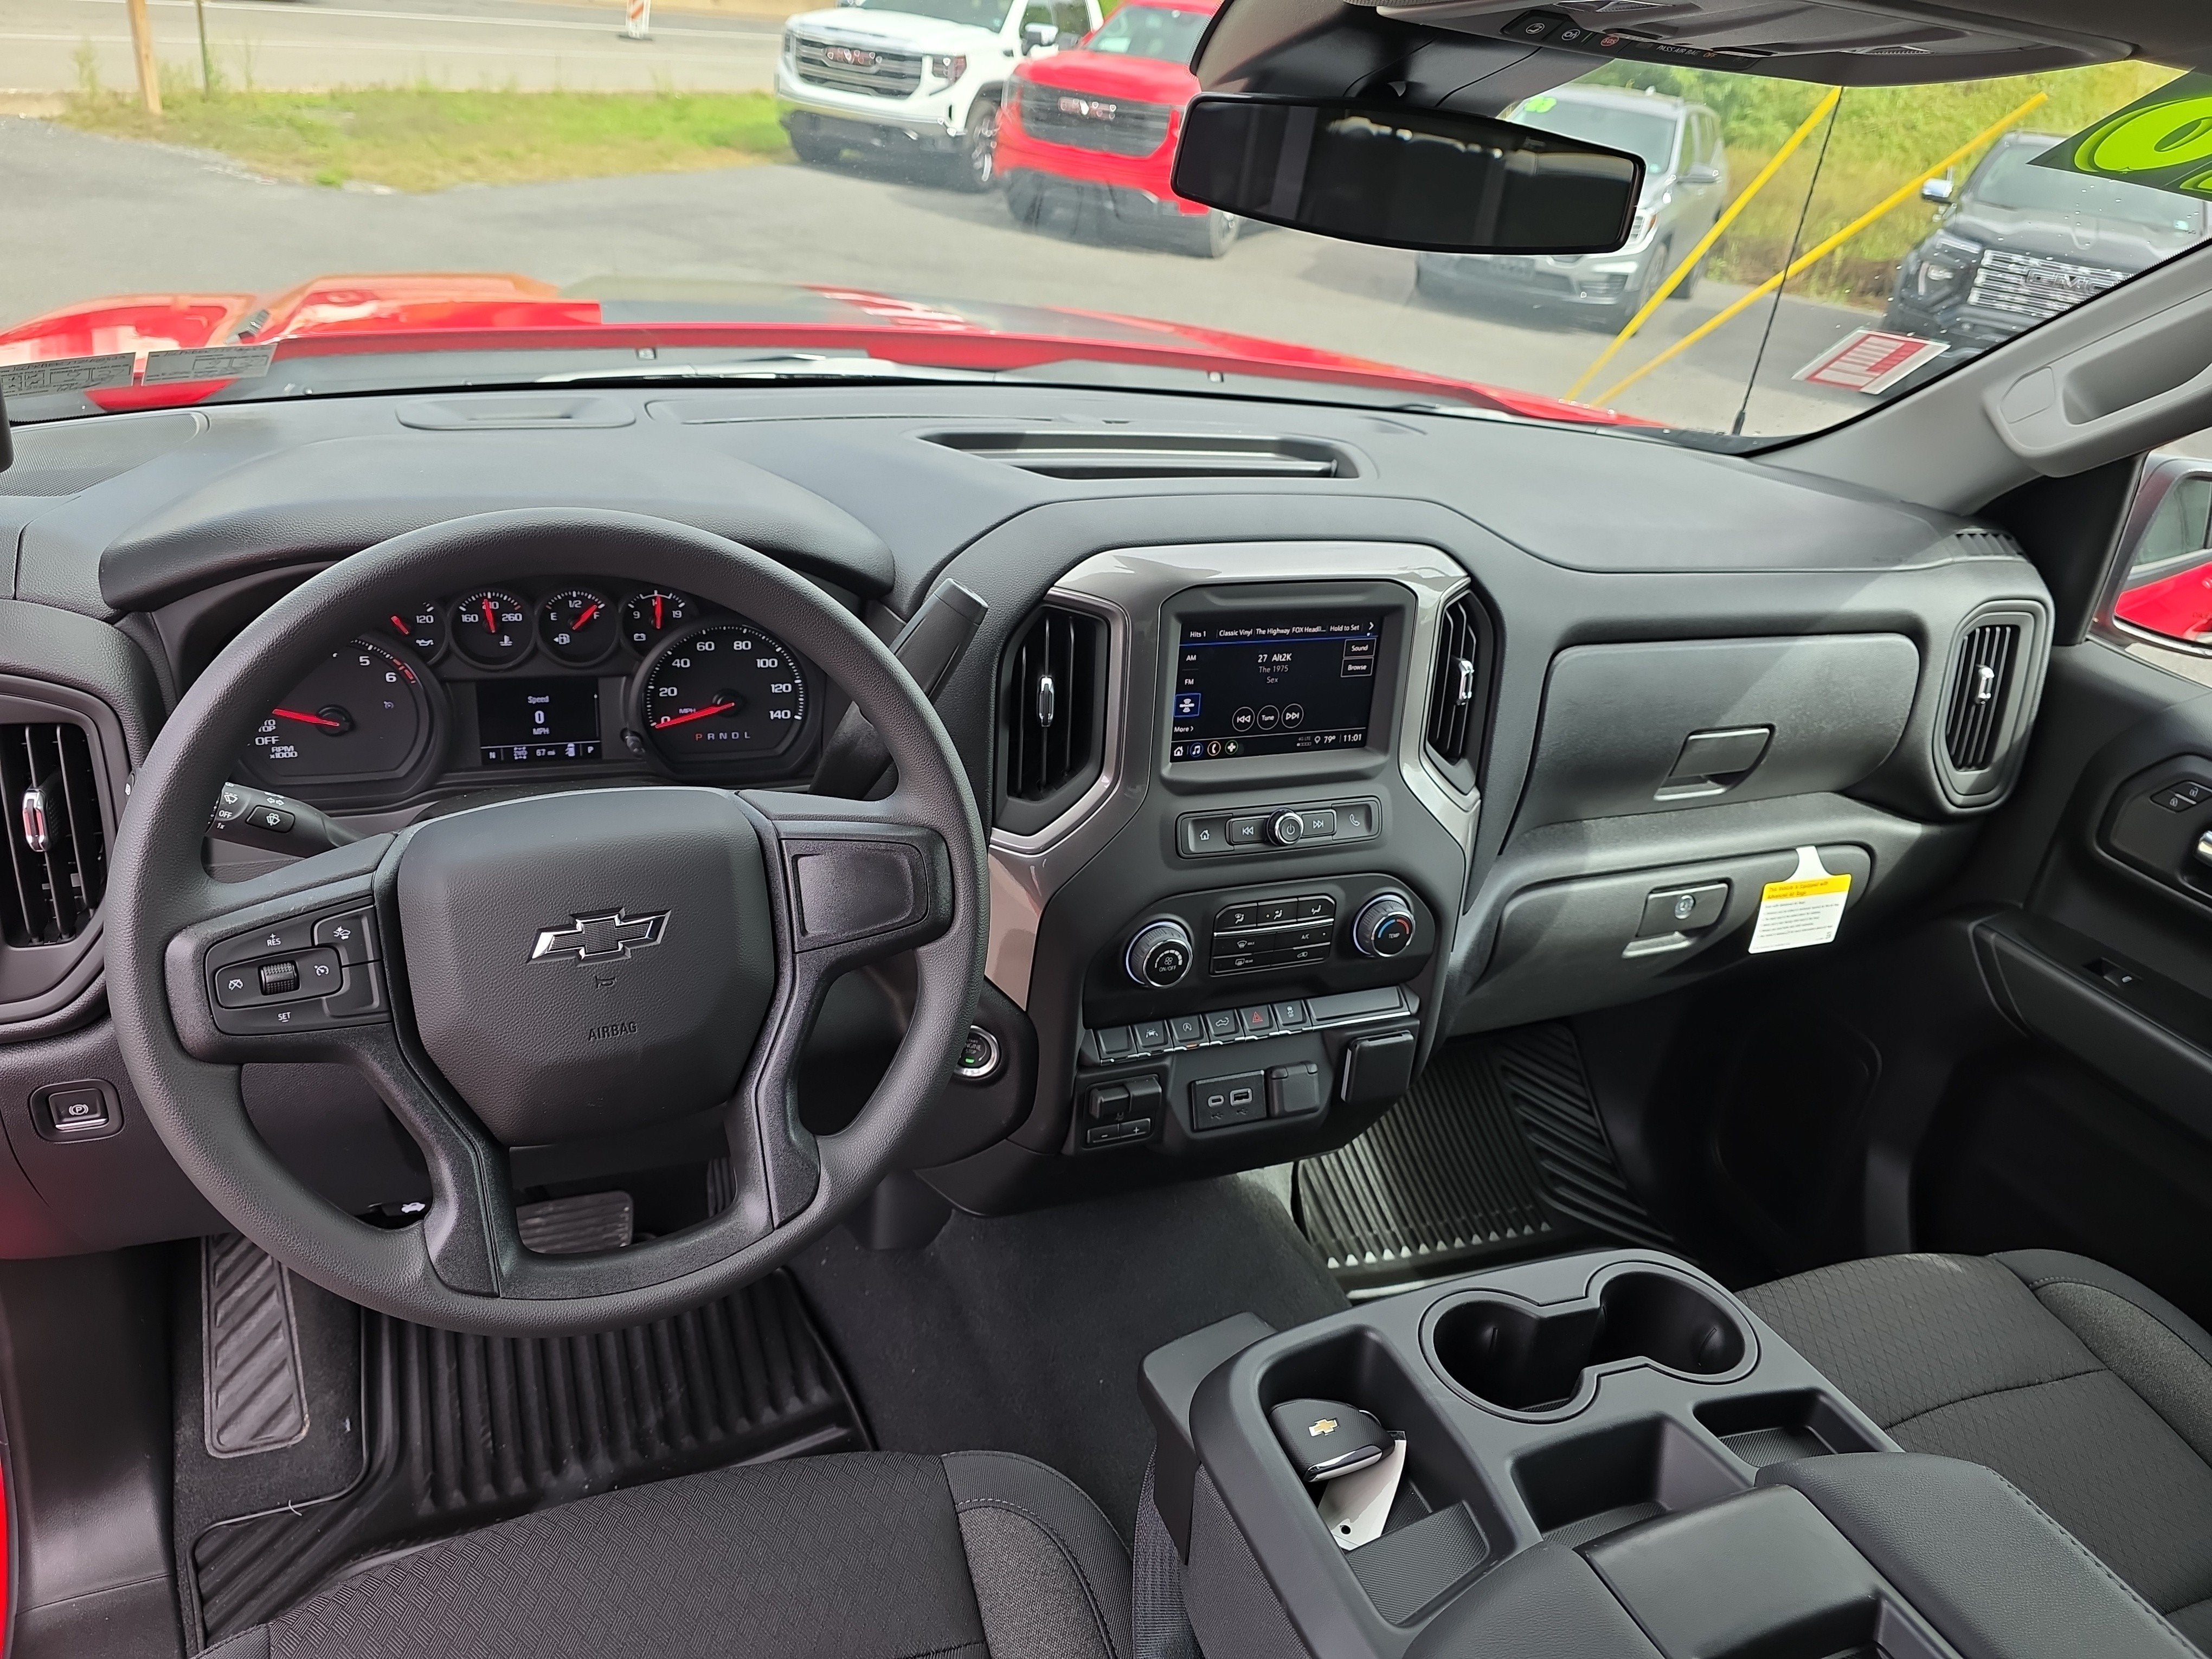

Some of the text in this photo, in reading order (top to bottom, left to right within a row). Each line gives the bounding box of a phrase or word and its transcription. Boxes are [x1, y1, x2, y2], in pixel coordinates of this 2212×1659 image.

[416, 615, 434, 623] 120
[461, 614, 479, 622] 160
[502, 613, 523, 622] 260
[550, 613, 557, 621] E
[593, 612, 600, 620] F
[633, 611, 641, 619] 9
[1267, 627, 1290, 636] Highway
[696, 641, 715, 651] 60
[734, 641, 751, 651] 80
[359, 656, 370, 666] 5
[1258, 653, 1292, 663] 27 Alt2K
[672, 659, 691, 668] 40
[756, 658, 778, 668] 100
[385, 673, 396, 683] 6
[659, 687, 678, 697] 20
[771, 684, 792, 693] 120
[528, 696, 549, 704] Speed
[535, 710, 544, 724] 0
[769, 710, 791, 720] 140
[255, 736, 280, 745] OFF
[1343, 734, 1362, 742] 11:01
[219, 810, 233, 819] OFF
[267, 938, 281, 947] RES
[278, 1012, 291, 1021] SET
[588, 1022, 638, 1041] AIRBAG
